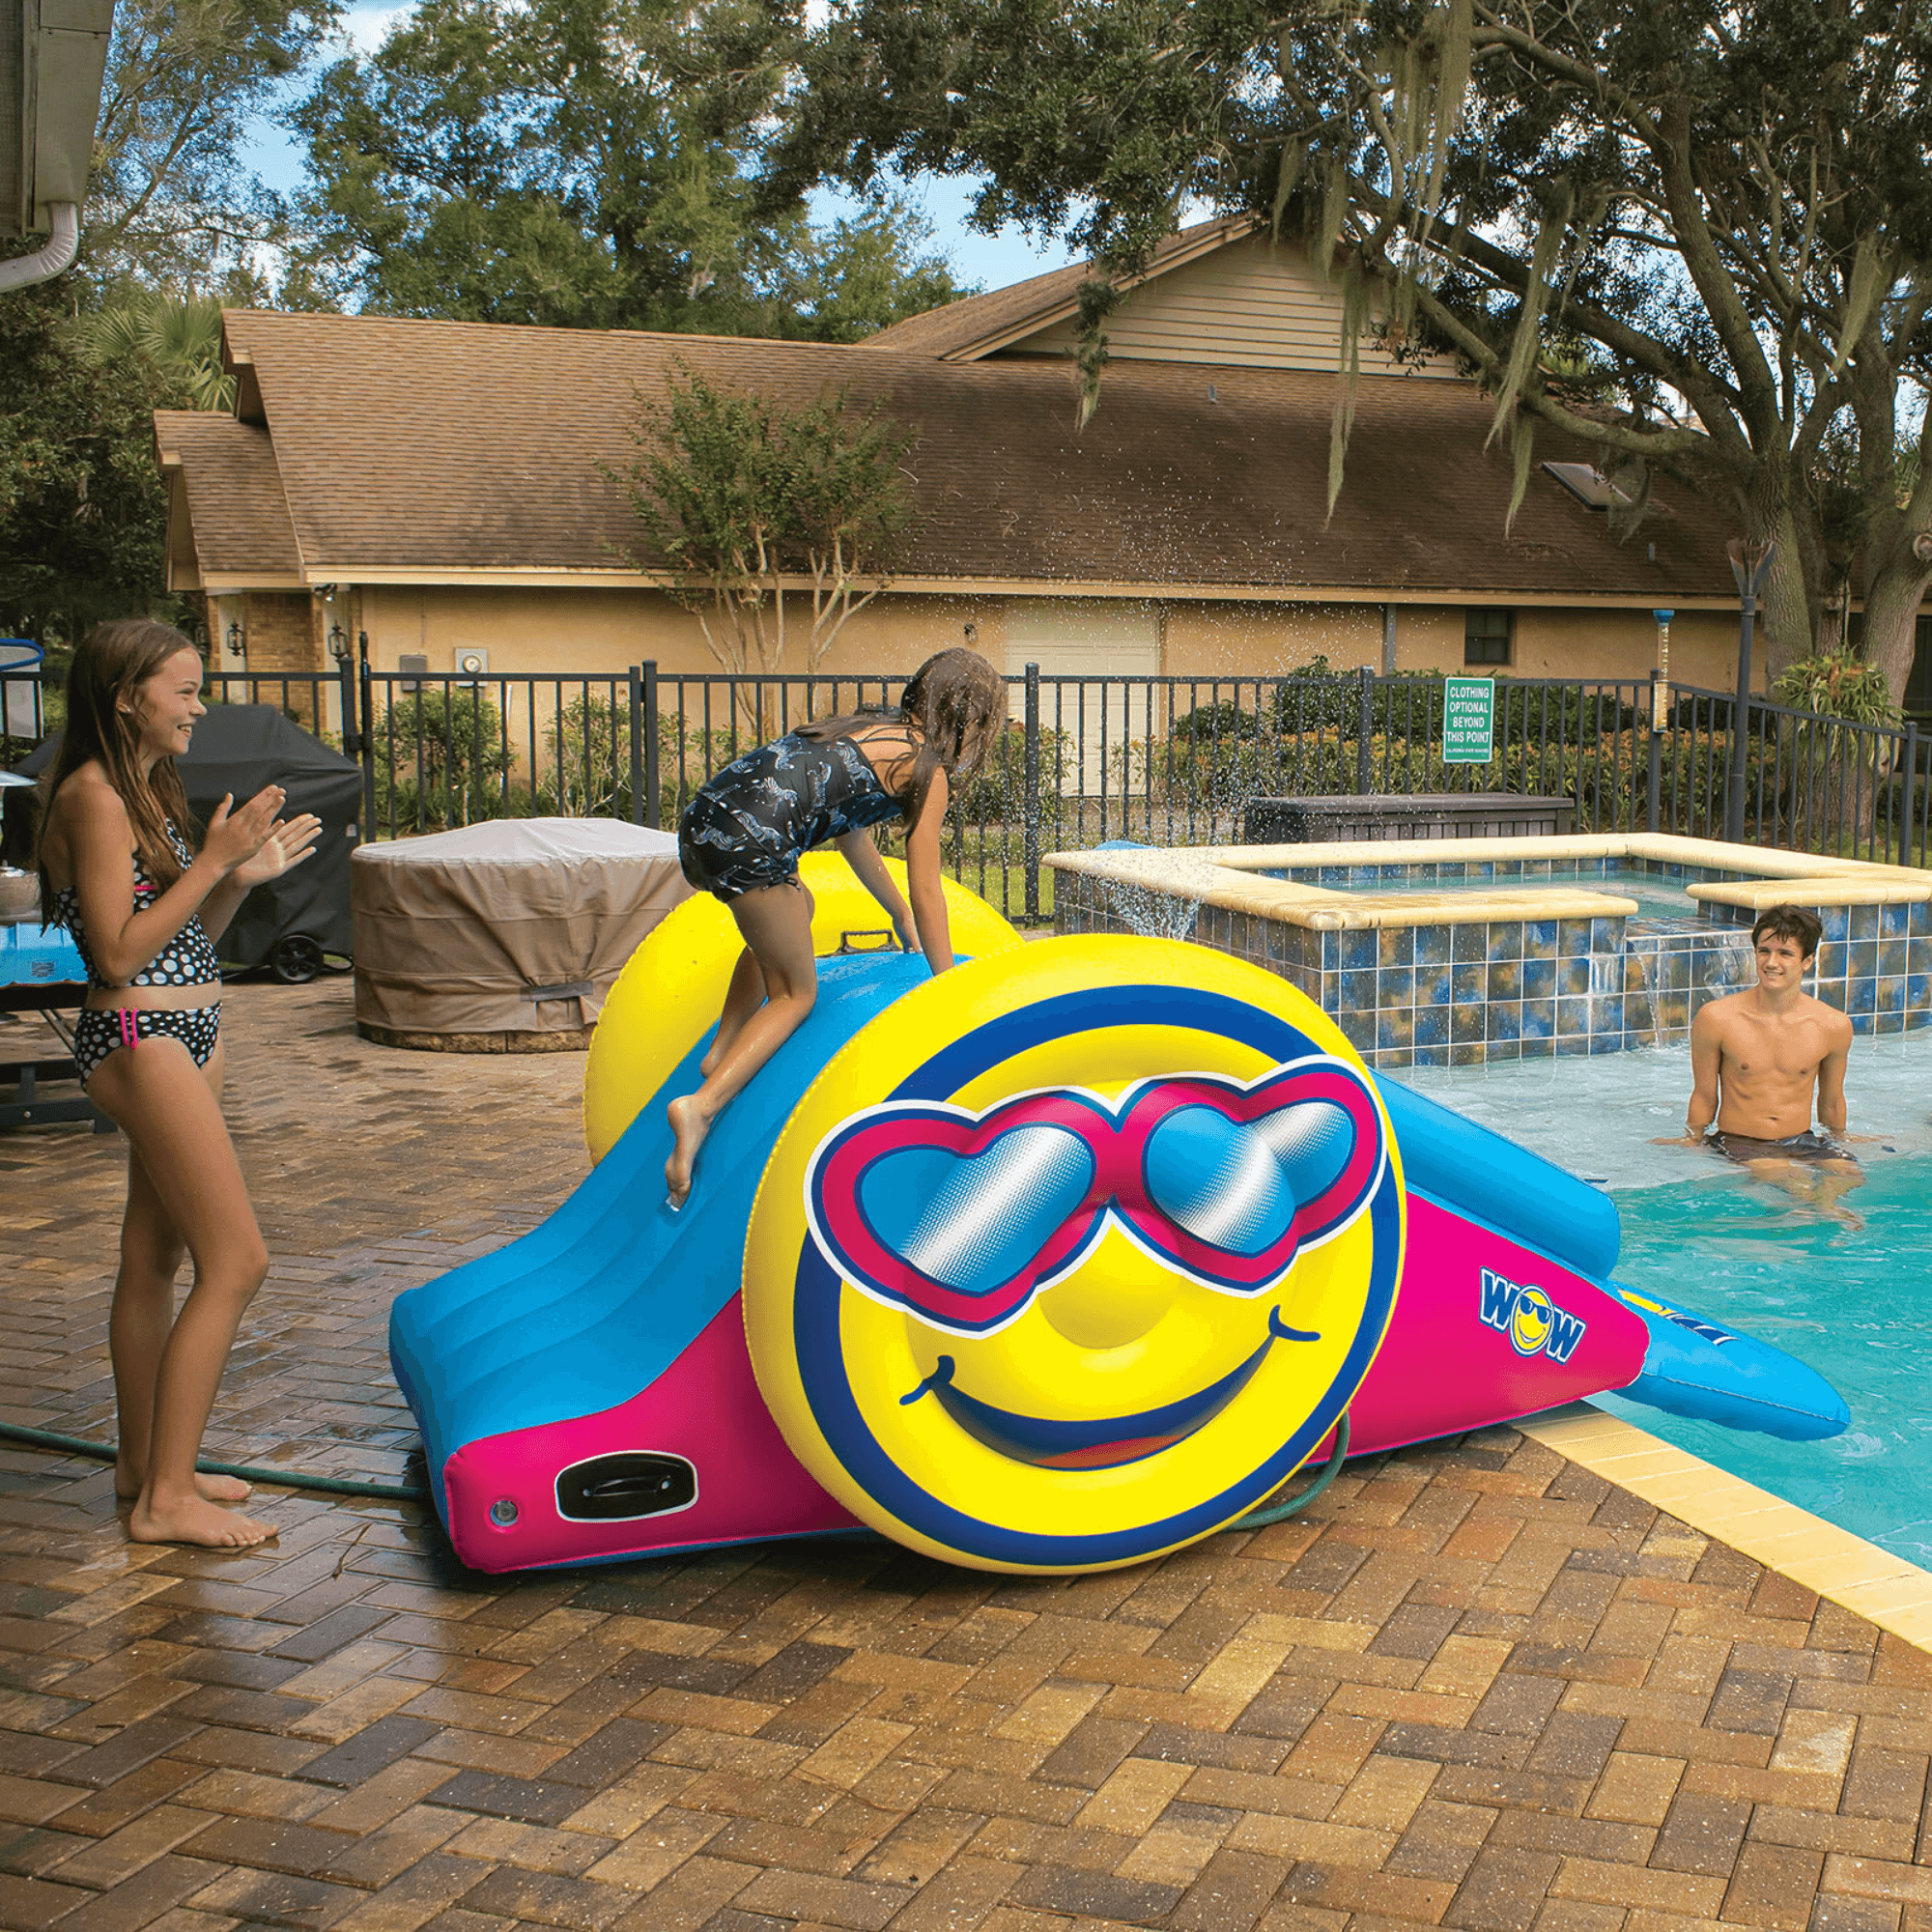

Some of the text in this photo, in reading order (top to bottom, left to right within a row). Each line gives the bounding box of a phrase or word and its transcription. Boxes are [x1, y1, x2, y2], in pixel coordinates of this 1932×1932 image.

[1450, 686, 1490, 698] CLOTHING
[1449, 701, 1489, 713] OPTIONAL
[1453, 716, 1485, 727] BEYOND
[1447, 731, 1489, 743] THIS POINT
[1479, 1265, 1587, 1365] WOW
